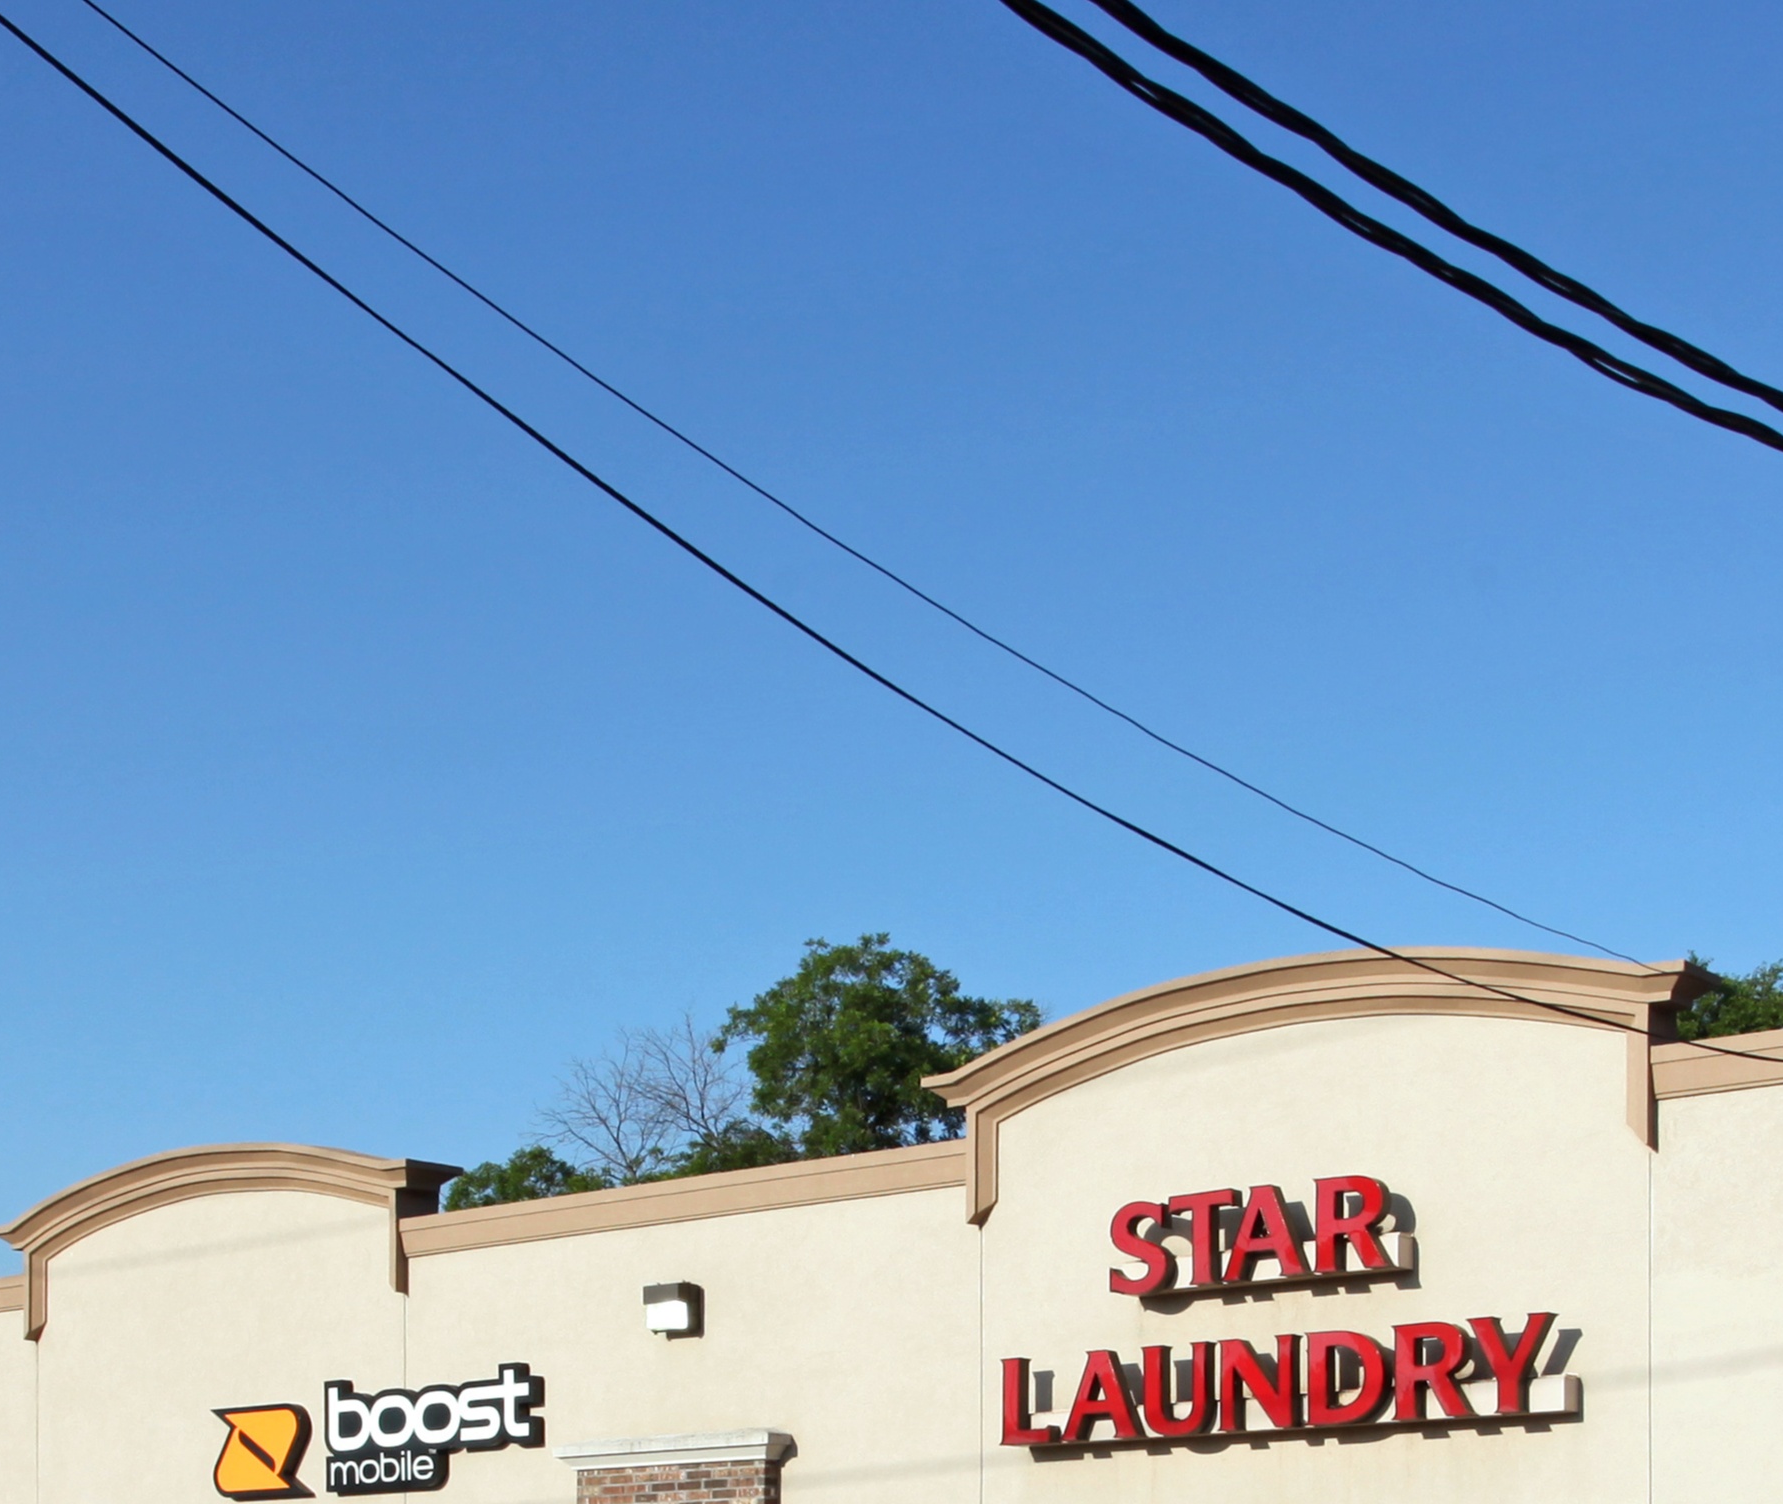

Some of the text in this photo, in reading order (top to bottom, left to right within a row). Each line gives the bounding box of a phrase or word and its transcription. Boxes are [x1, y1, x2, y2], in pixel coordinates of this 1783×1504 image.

[1108, 1175, 1393, 1296] STAR
[327, 1369, 530, 1452] boost
[1000, 1312, 1559, 1446] LAUNDRY
[330, 1450, 434, 1486] mobile
